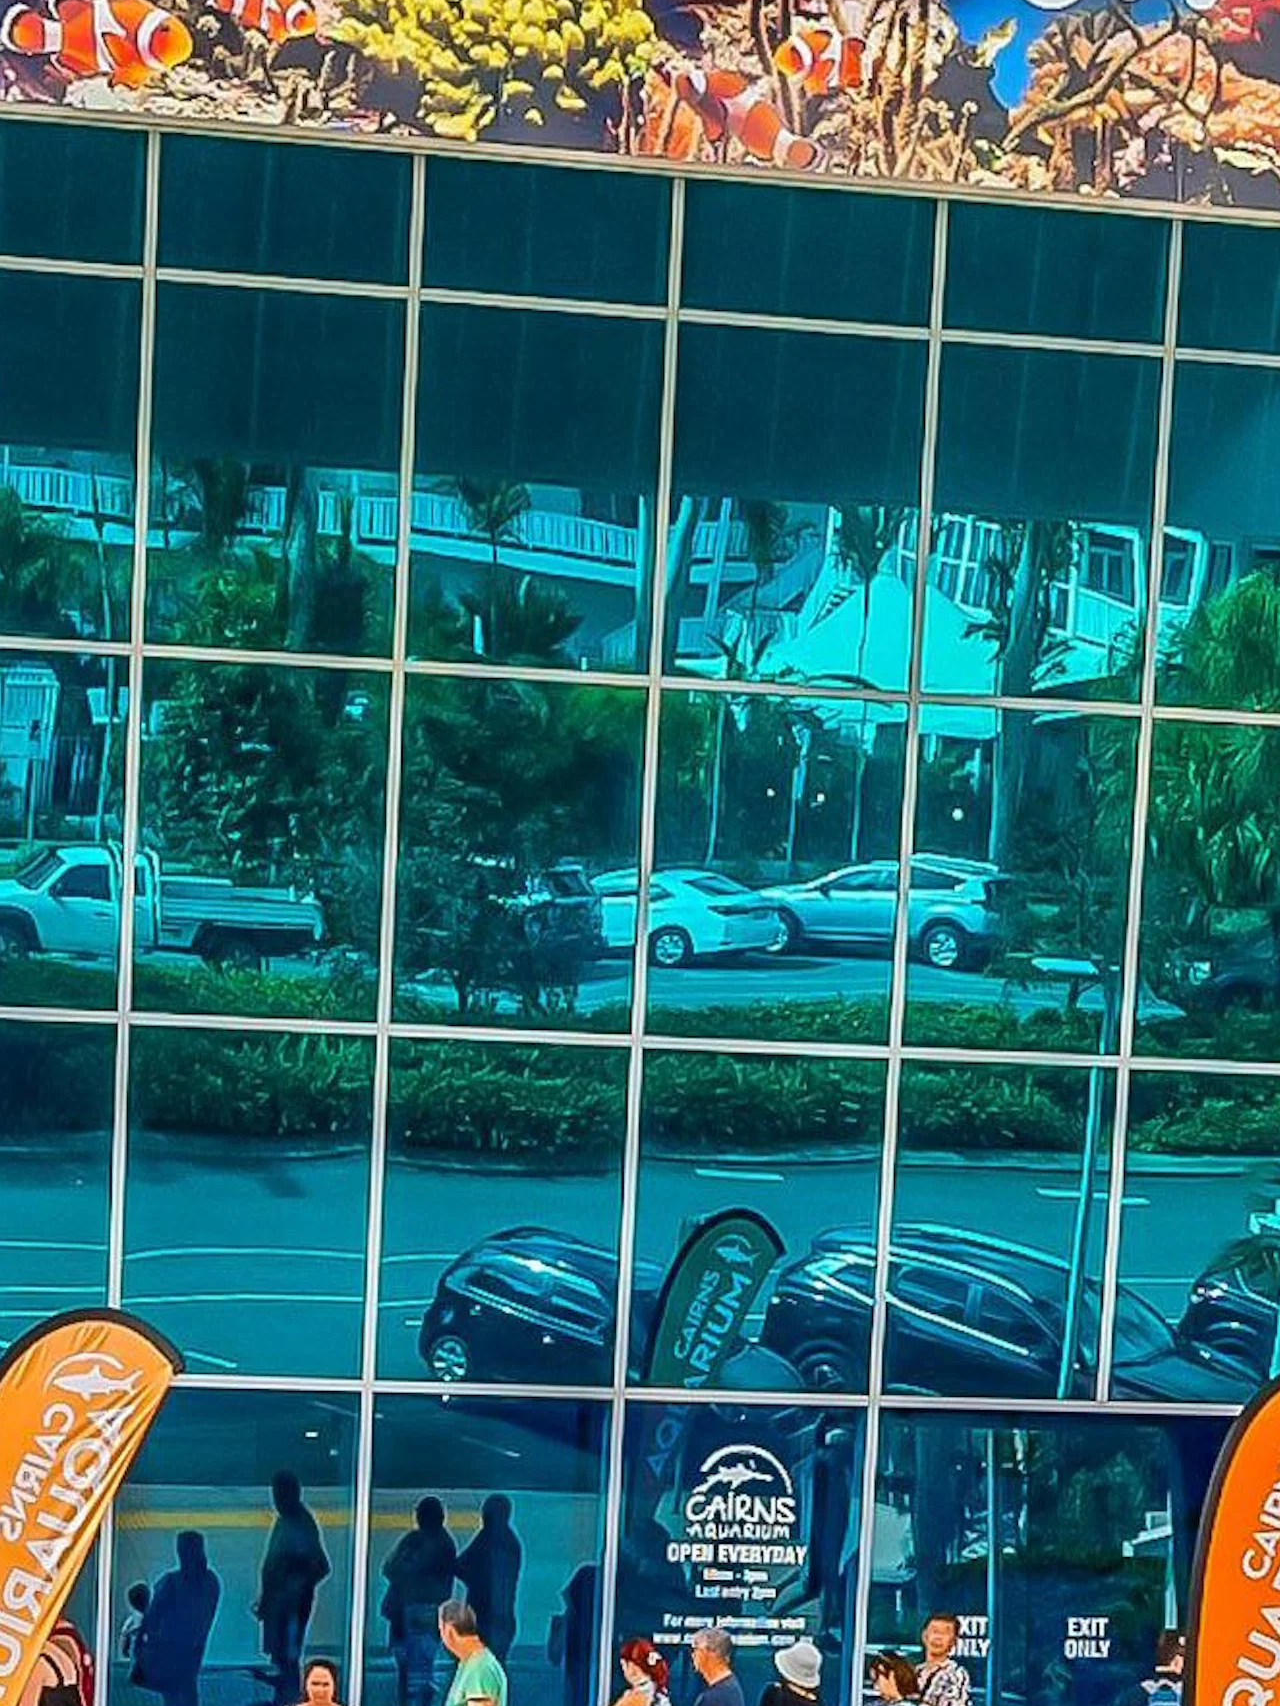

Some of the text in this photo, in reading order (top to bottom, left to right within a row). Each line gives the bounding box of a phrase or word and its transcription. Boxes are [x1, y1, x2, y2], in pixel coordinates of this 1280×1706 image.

[674, 1269, 721, 1360] CAIRNS
[686, 1523, 791, 1540] AQUARIUM
[666, 1542, 808, 1566] OPEN EVERYDAY
[956, 1615, 989, 1636] XIT
[1067, 1617, 1109, 1637] EXIT
[1064, 1640, 1111, 1659] ONLY
